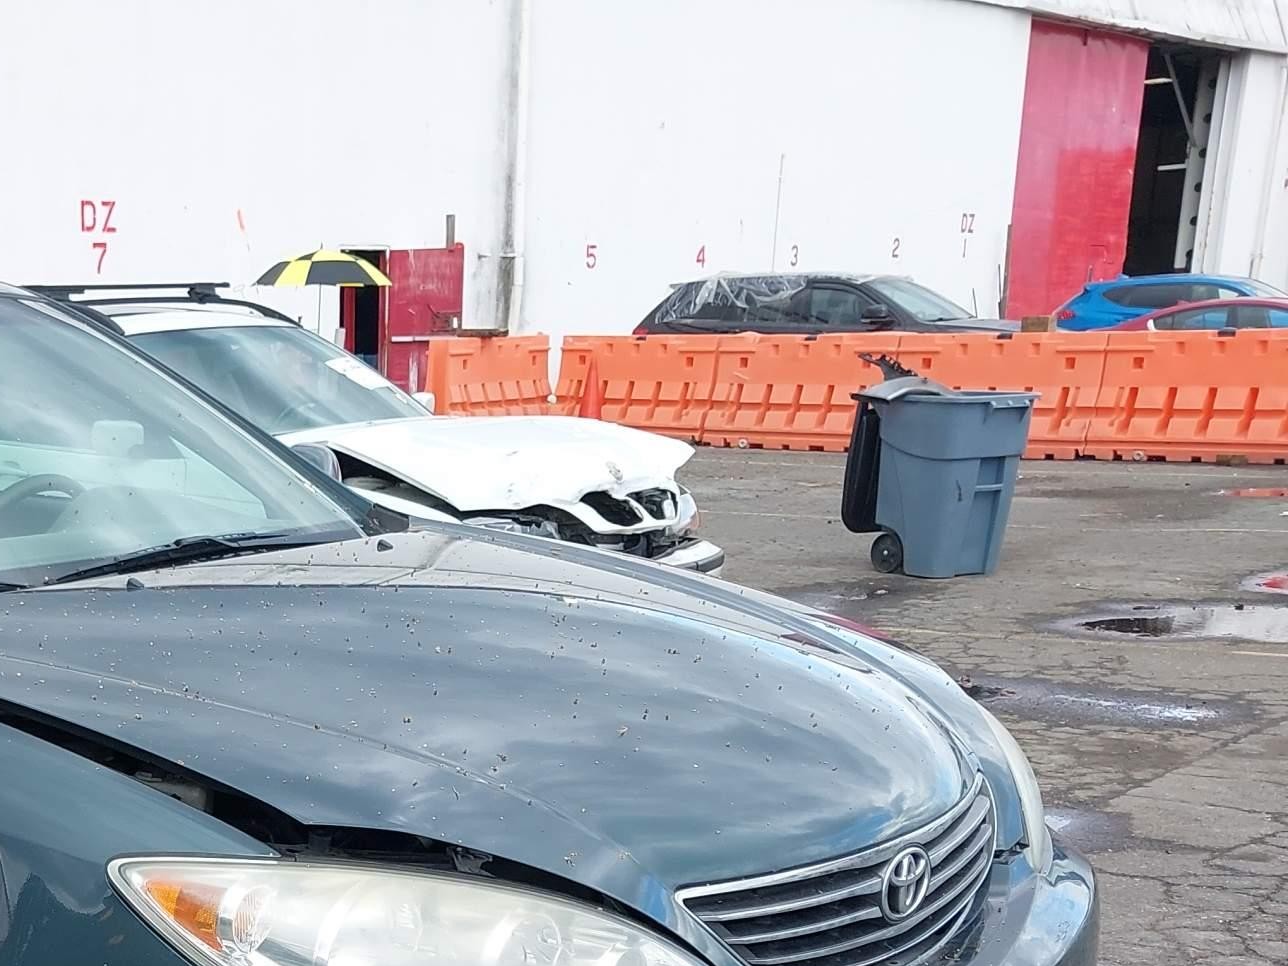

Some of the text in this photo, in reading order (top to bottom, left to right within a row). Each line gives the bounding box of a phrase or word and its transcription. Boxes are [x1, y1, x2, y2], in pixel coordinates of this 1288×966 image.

[79, 199, 117, 233] DZ
[960, 212, 976, 234] DZ
[92, 242, 107, 275] 7
[585, 243, 598, 270] 5
[695, 244, 706, 269] 4
[790, 244, 799, 267] 3
[891, 237, 900, 259] 2
